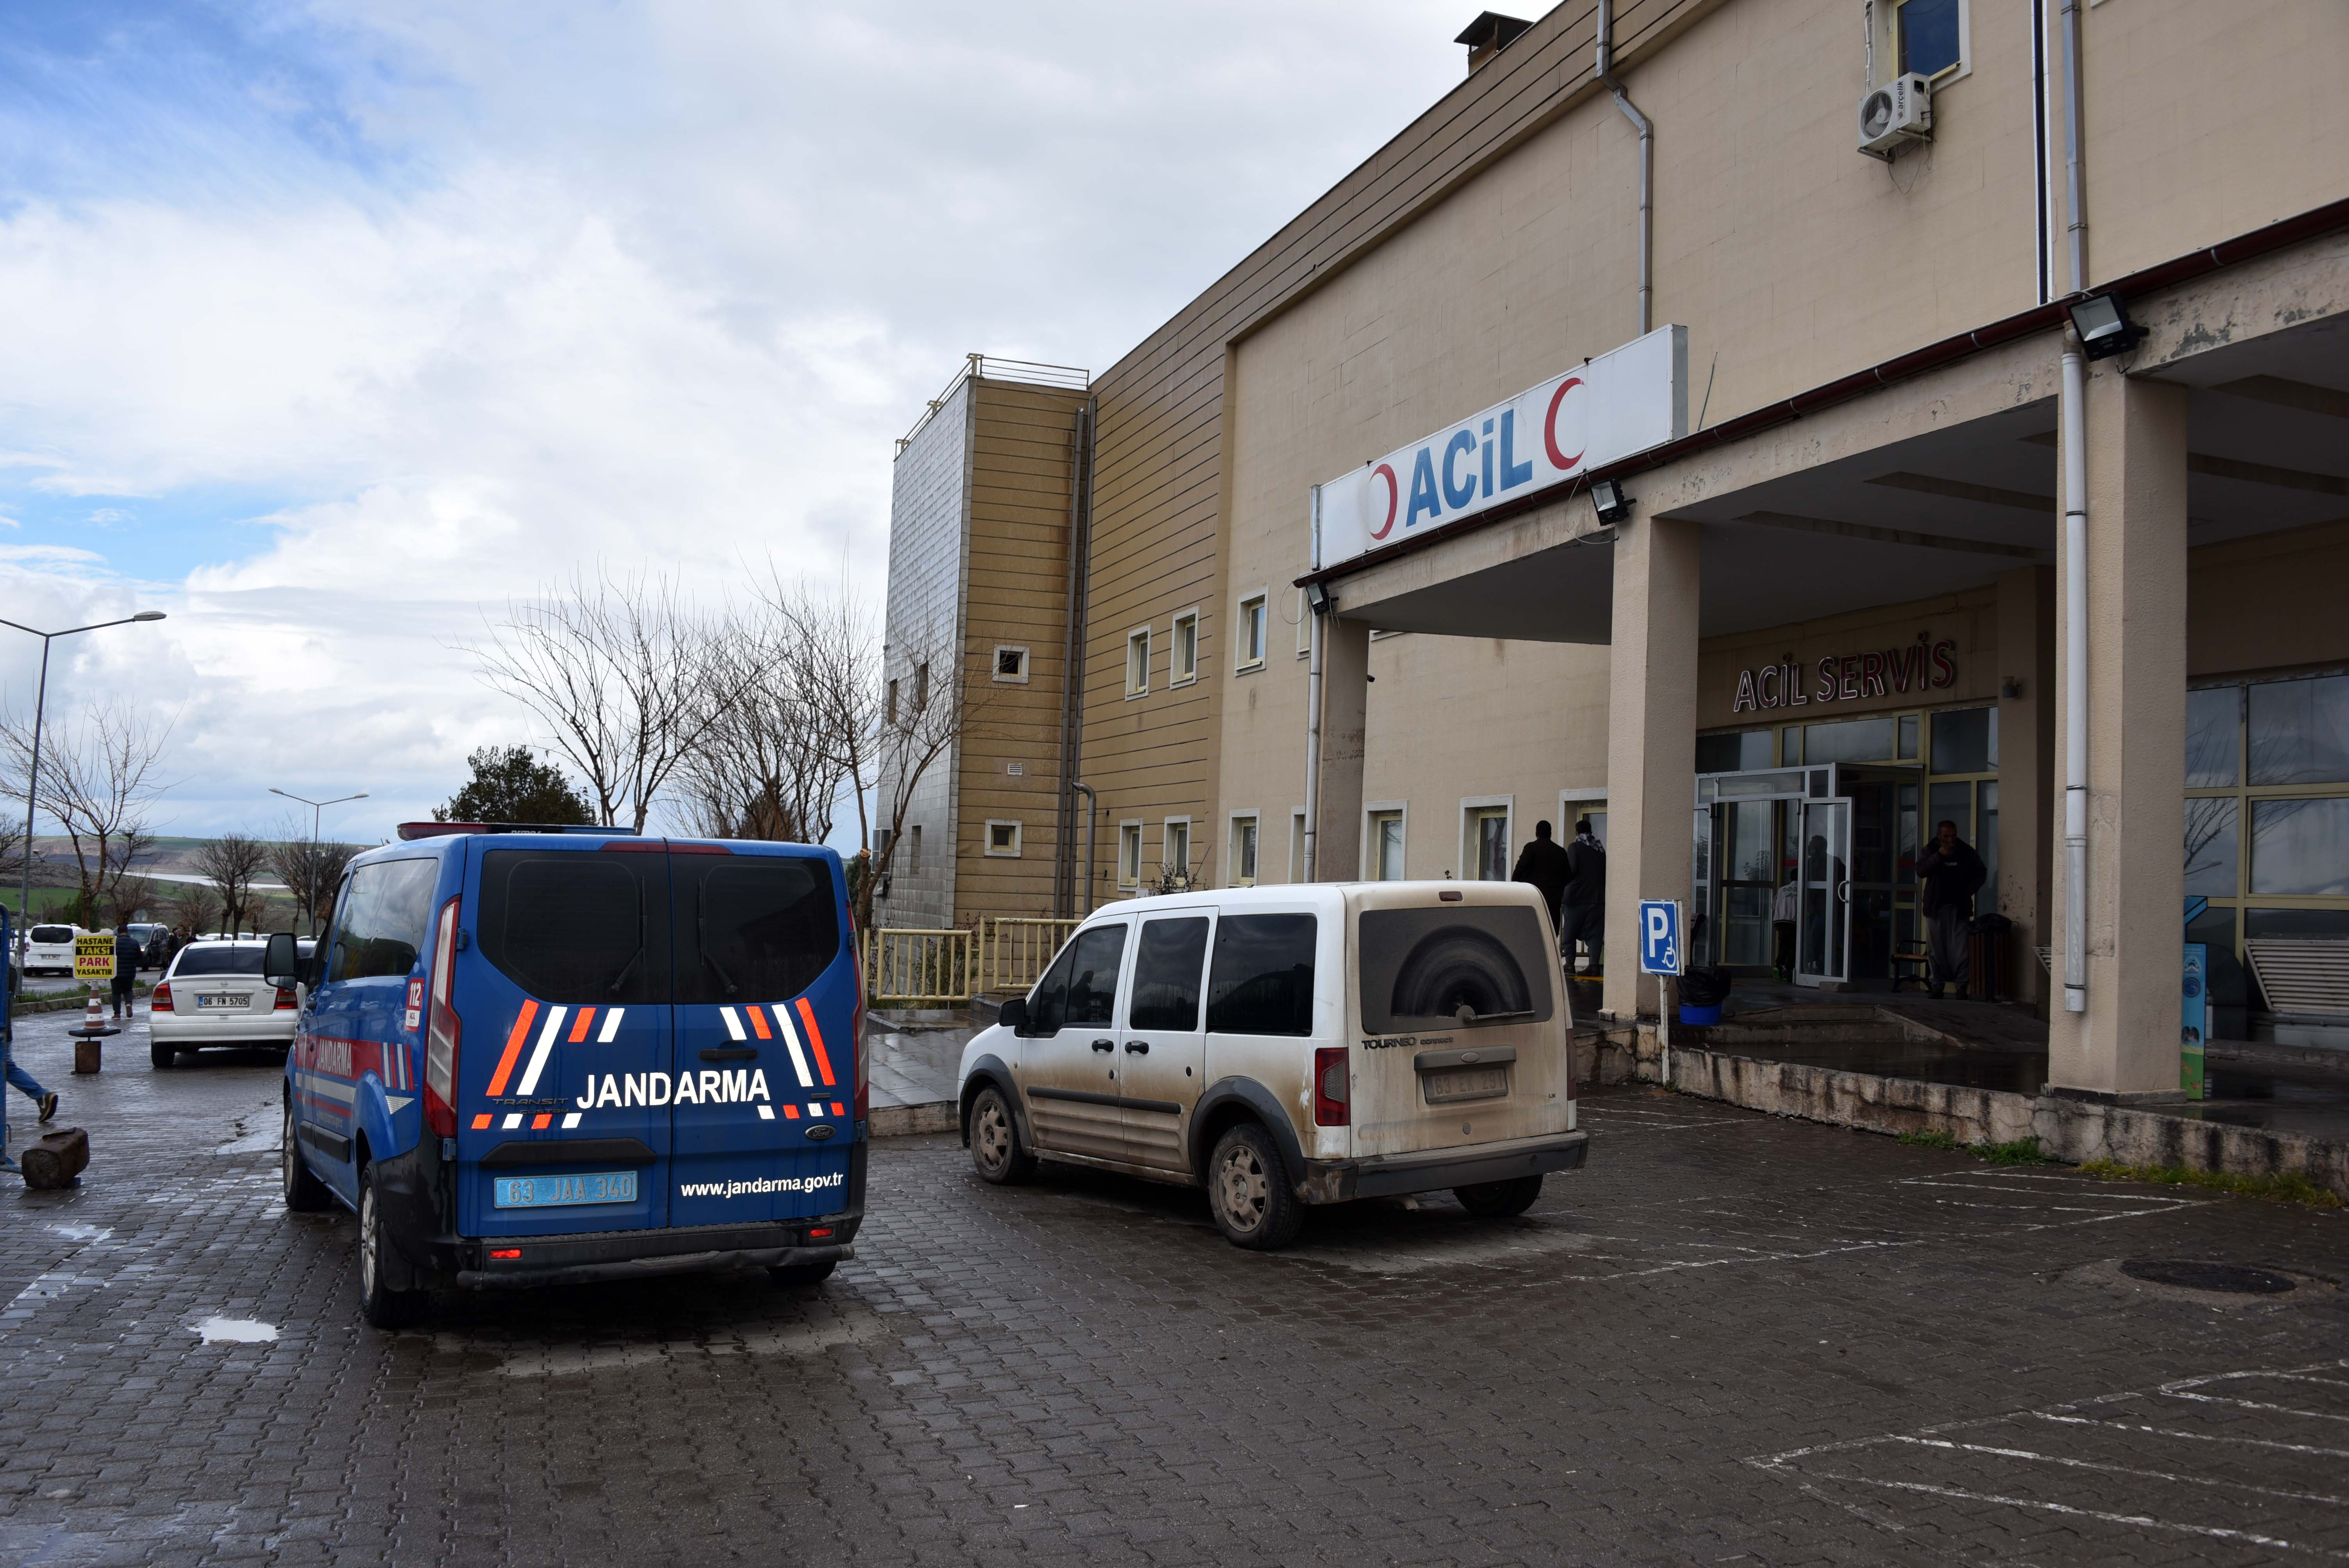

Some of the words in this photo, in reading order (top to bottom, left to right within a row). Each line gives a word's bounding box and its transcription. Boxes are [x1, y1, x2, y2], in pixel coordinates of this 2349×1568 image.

[1734, 653, 1807, 712] ACİL
[1817, 631, 1953, 702] SERVİS
[1647, 908, 1668, 958] P
[79, 957, 110, 966] PARK
[409, 982, 421, 1006] 112
[1362, 1037, 1417, 1049] TOURNEO
[1420, 1036, 1454, 1045] connect
[317, 1039, 351, 1077] JANDARMA
[577, 1069, 770, 1109] JANDARMA
[1435, 1076, 1451, 1094] 63
[1457, 1074, 1475, 1092] EK
[510, 1181, 534, 1203] 63
[550, 1177, 586, 1201] JAA
[596, 1176, 633, 1199] 340
[681, 1172, 843, 1198] www.jandarma.gov.tr
